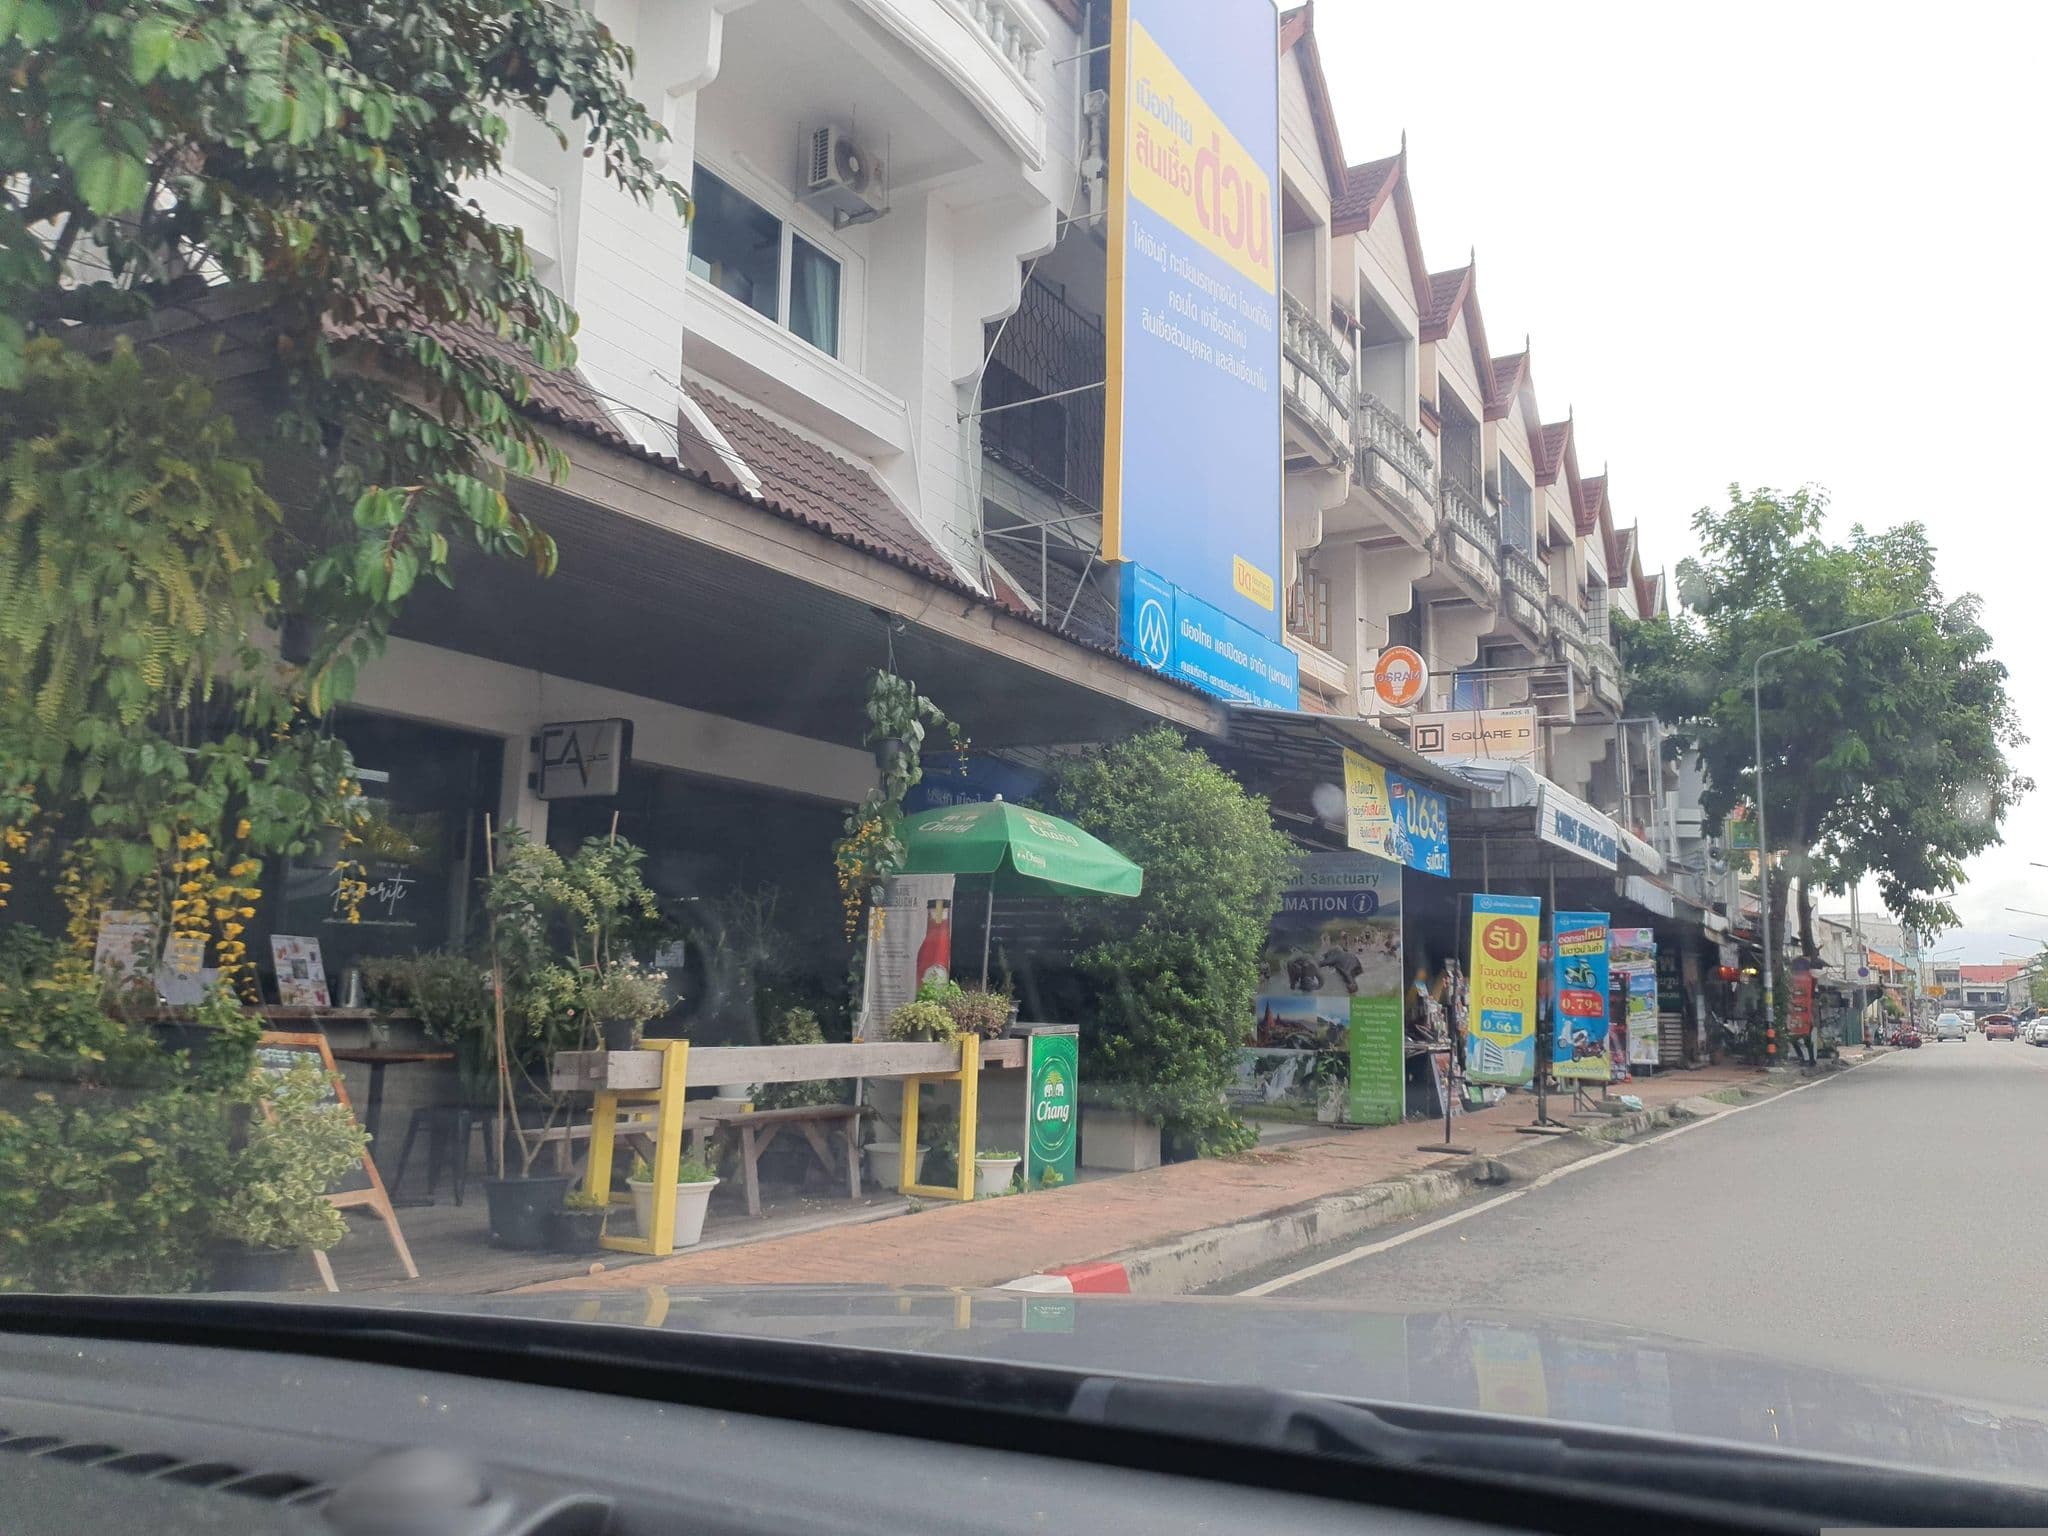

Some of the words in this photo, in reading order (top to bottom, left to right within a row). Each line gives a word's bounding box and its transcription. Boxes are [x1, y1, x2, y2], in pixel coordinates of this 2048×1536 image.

[1136, 77, 1192, 146] เมืองไทย
[1136, 121, 1192, 197] สินเชื่อ
[1194, 130, 1268, 270] ด่วน
[1168, 290, 1198, 321] คอนโด
[1376, 671, 1421, 682] OSRAM
[1451, 730, 1512, 741] SQUARE
[1518, 728, 1530, 738] D
[1029, 824, 1079, 848] Chang
[1310, 873, 1380, 887] Sanctuary
[1285, 896, 1347, 911] MATION
[1488, 925, 1520, 951] รับ
[1036, 1099, 1070, 1122] Chang
